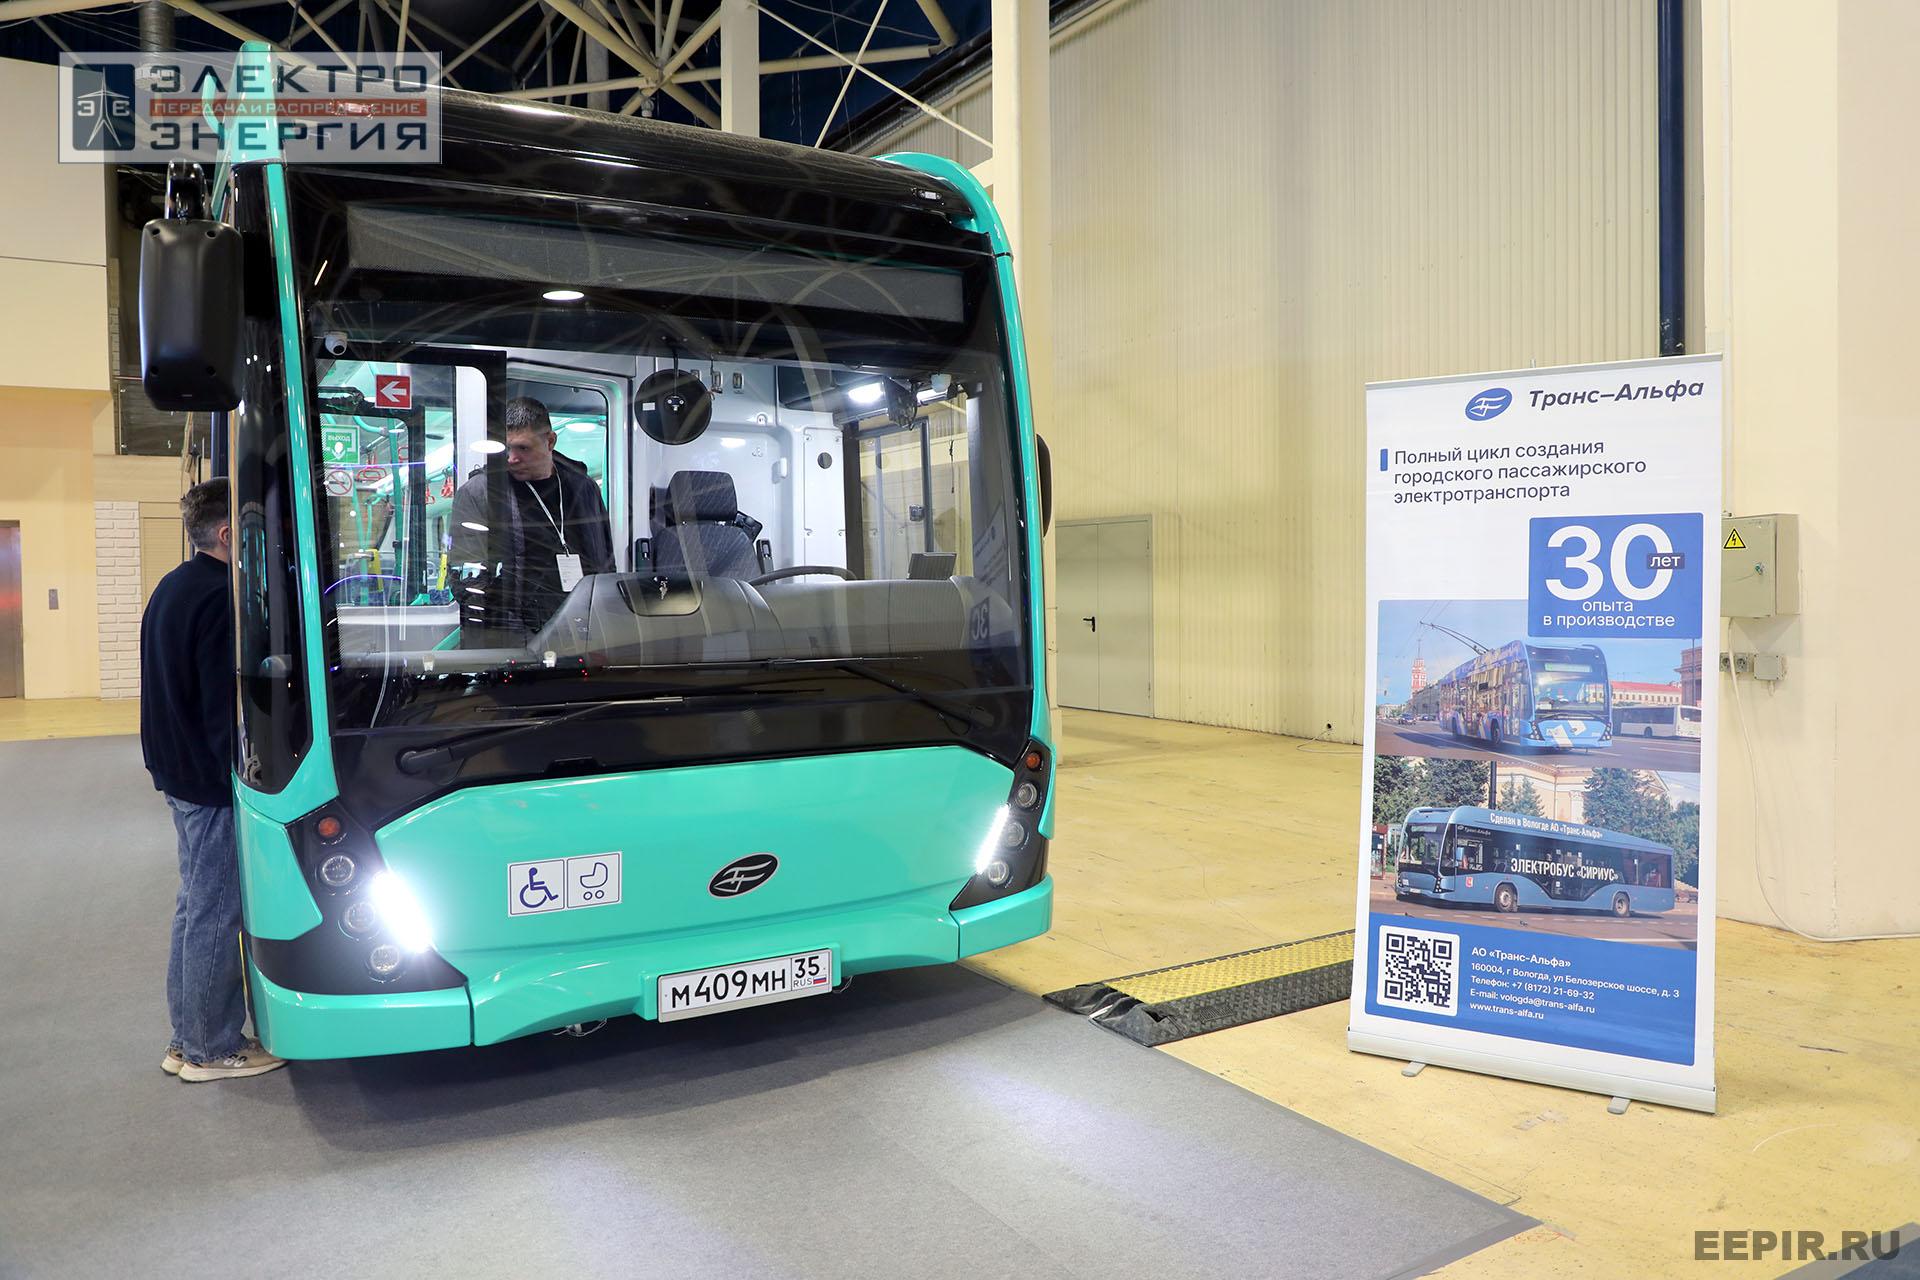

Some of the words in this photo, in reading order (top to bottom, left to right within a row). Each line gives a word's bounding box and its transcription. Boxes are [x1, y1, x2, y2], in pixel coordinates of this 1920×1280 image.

[1394, 447, 1462, 465] Полный
[1467, 446, 1510, 463] цикл
[1515, 440, 1604, 460] создания
[1394, 466, 1493, 487] городского
[1498, 459, 1646, 480] пассажирского
[1394, 483, 1570, 504] электротранспорта
[1545, 523, 1674, 601] 30
[1650, 554, 1681, 569] лет
[1583, 600, 1634, 615] опыта
[1543, 615, 1552, 626] в
[1557, 614, 1675, 628] производстве
[1490, 813, 1515, 827] Сделан
[1522, 818, 1549, 832] Вологде
[1511, 858, 1575, 877] ЭЛЕКТРОБУС
[1576, 865, 1619, 881] «СИРИУС»
[1471, 947, 1486, 957] АО
[794, 956, 820, 979] 35
[793, 977, 812, 988] RUS
[1471, 962, 1505, 976] 160004,
[1513, 968, 1551, 982] Вологда,
[1553, 975, 1564, 983] ул
[1565, 975, 1625, 991] Белозерское
[1627, 984, 1660, 996] шоссе,
[1662, 989, 1670, 998] д.
[1673, 989, 1680, 998] 3
[1471, 975, 1510, 989] Телефон:
[1512, 981, 1522, 990] +7
[1524, 982, 1551, 995] (8172)
[1553, 986, 1595, 1000] 21-69-32
[1469, 1003, 1545, 1020] www.trans-alfa.ru
[1470, 989, 1498, 1001] E-mail:
[1500, 992, 1596, 1014] vologda@trans-alfa.ru
